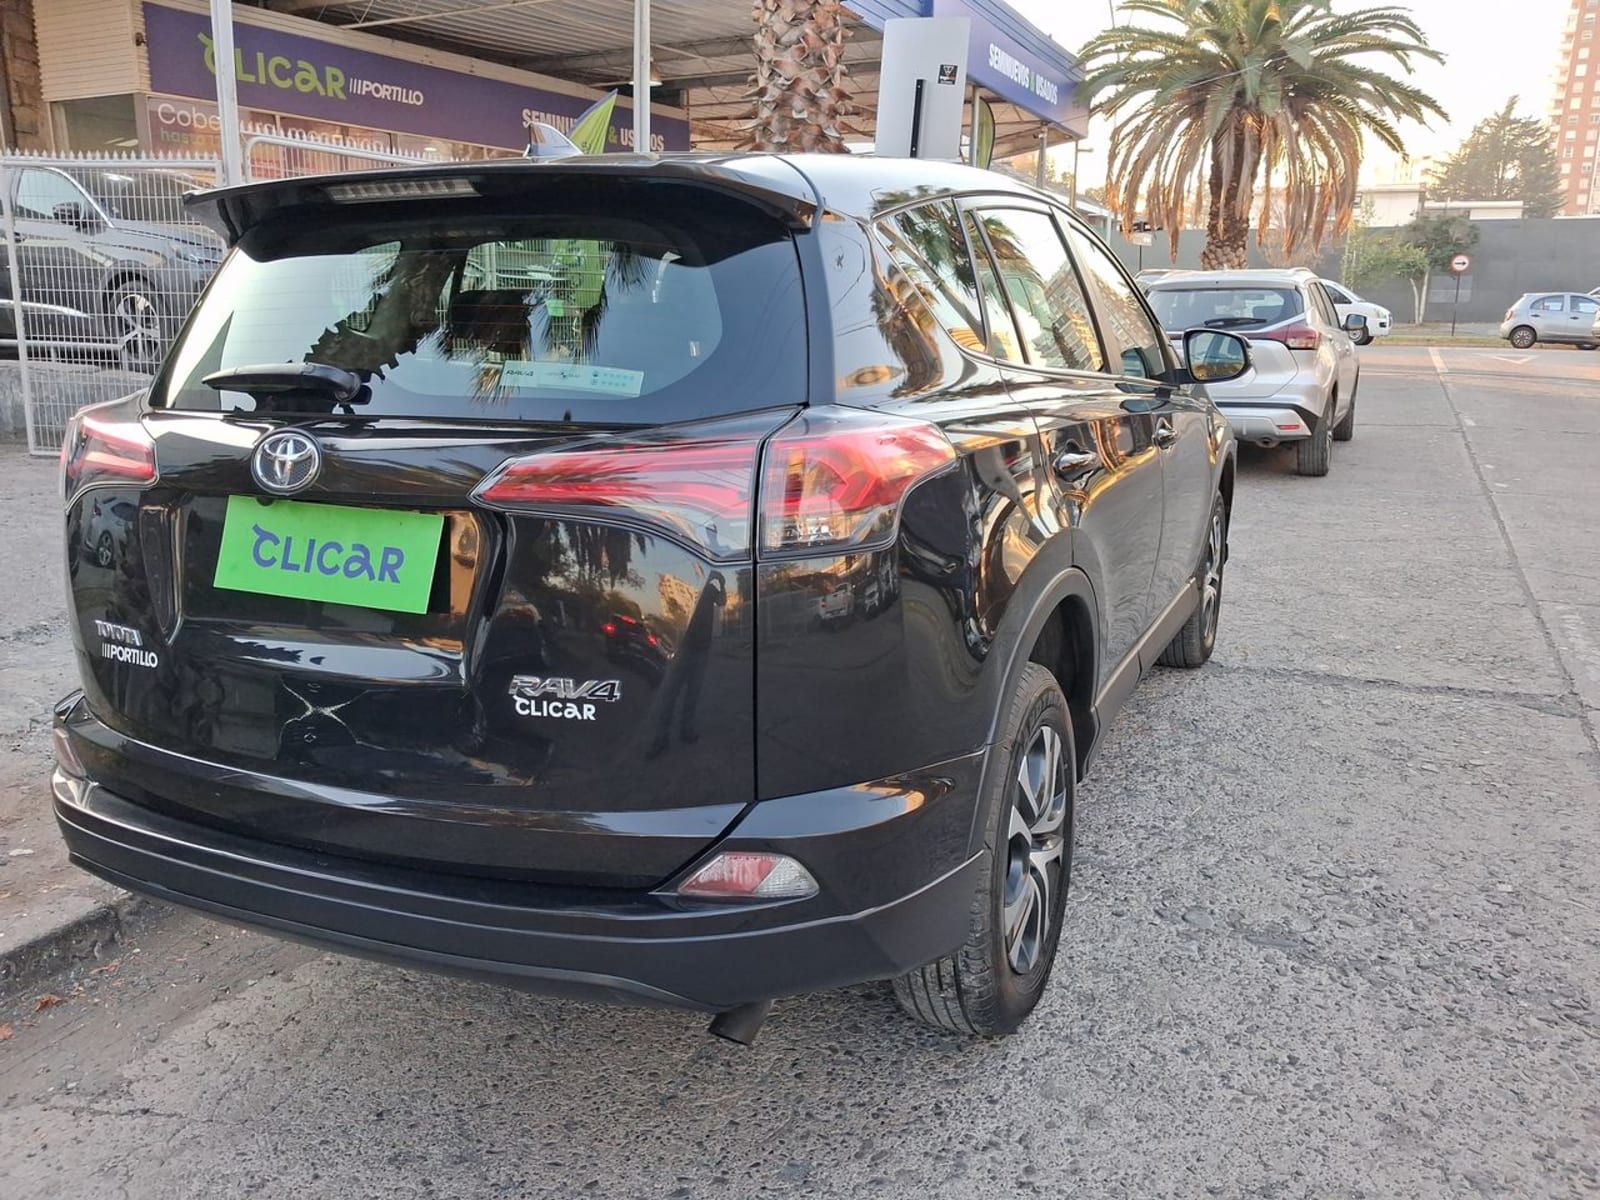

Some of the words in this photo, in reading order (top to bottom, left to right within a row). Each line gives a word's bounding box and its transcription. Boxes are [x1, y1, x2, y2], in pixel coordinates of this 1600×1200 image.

[158, 103, 277, 136] Cobeura
[620, 128, 665, 151] USOS
[95, 619, 143, 647] TOYOTA
[508, 675, 621, 702] RAV4
